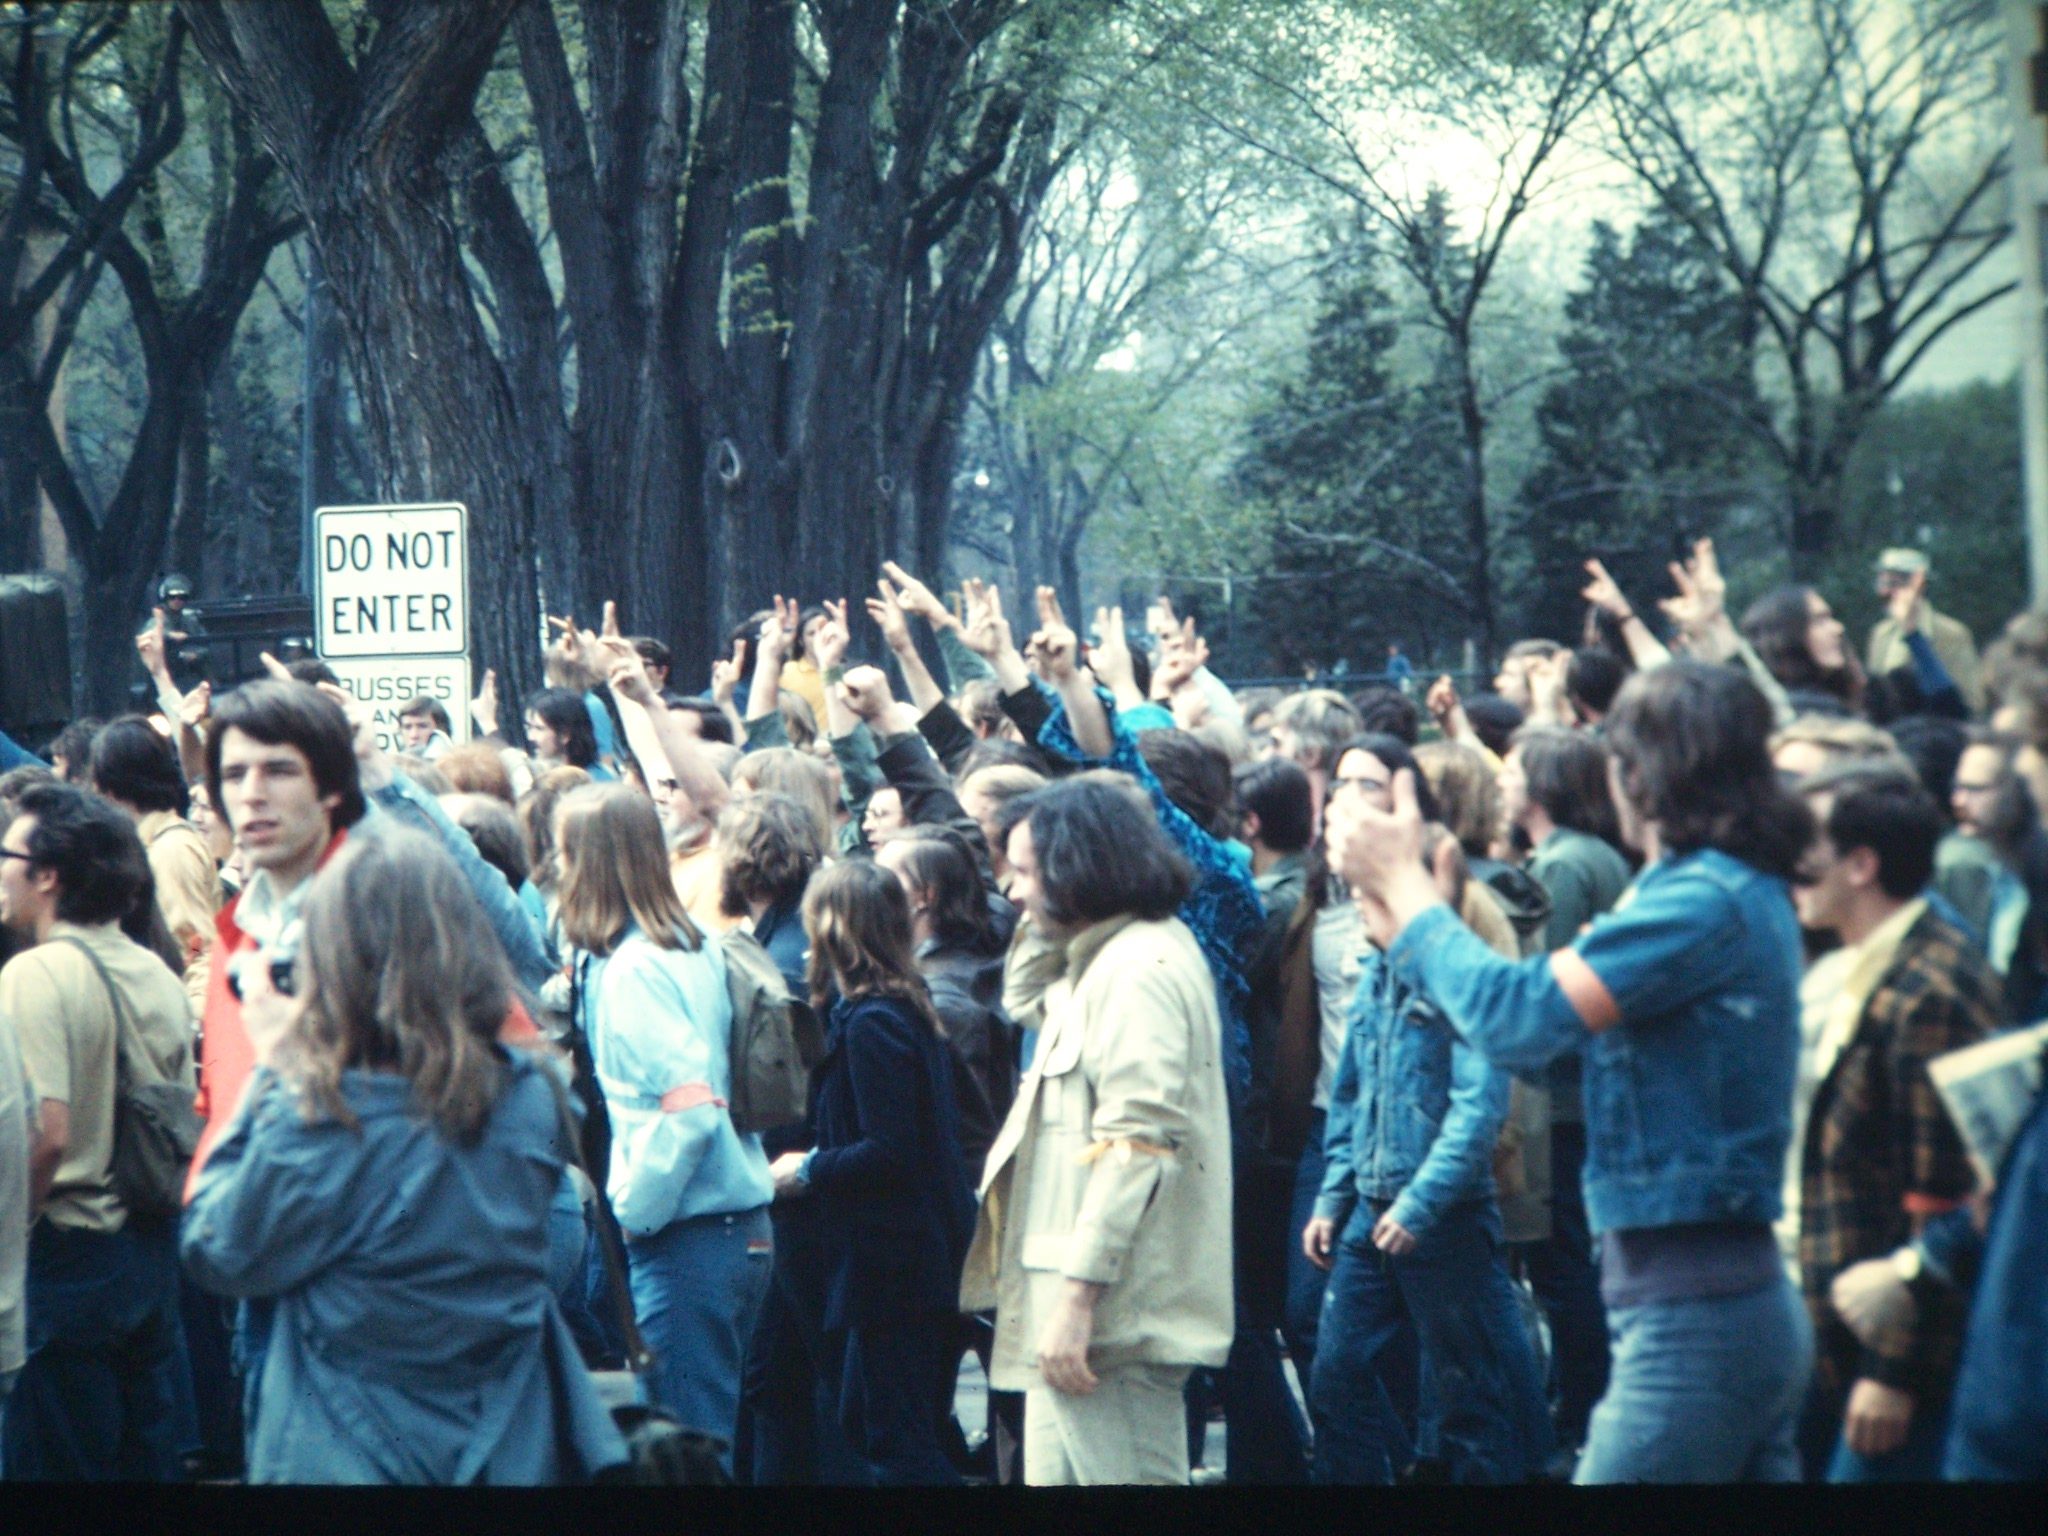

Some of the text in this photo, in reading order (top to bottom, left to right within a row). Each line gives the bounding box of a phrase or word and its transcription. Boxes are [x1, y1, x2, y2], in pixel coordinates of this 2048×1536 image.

[326, 531, 454, 572] DO NOT
[333, 594, 452, 634] ENTER
[372, 709, 401, 724] AN
